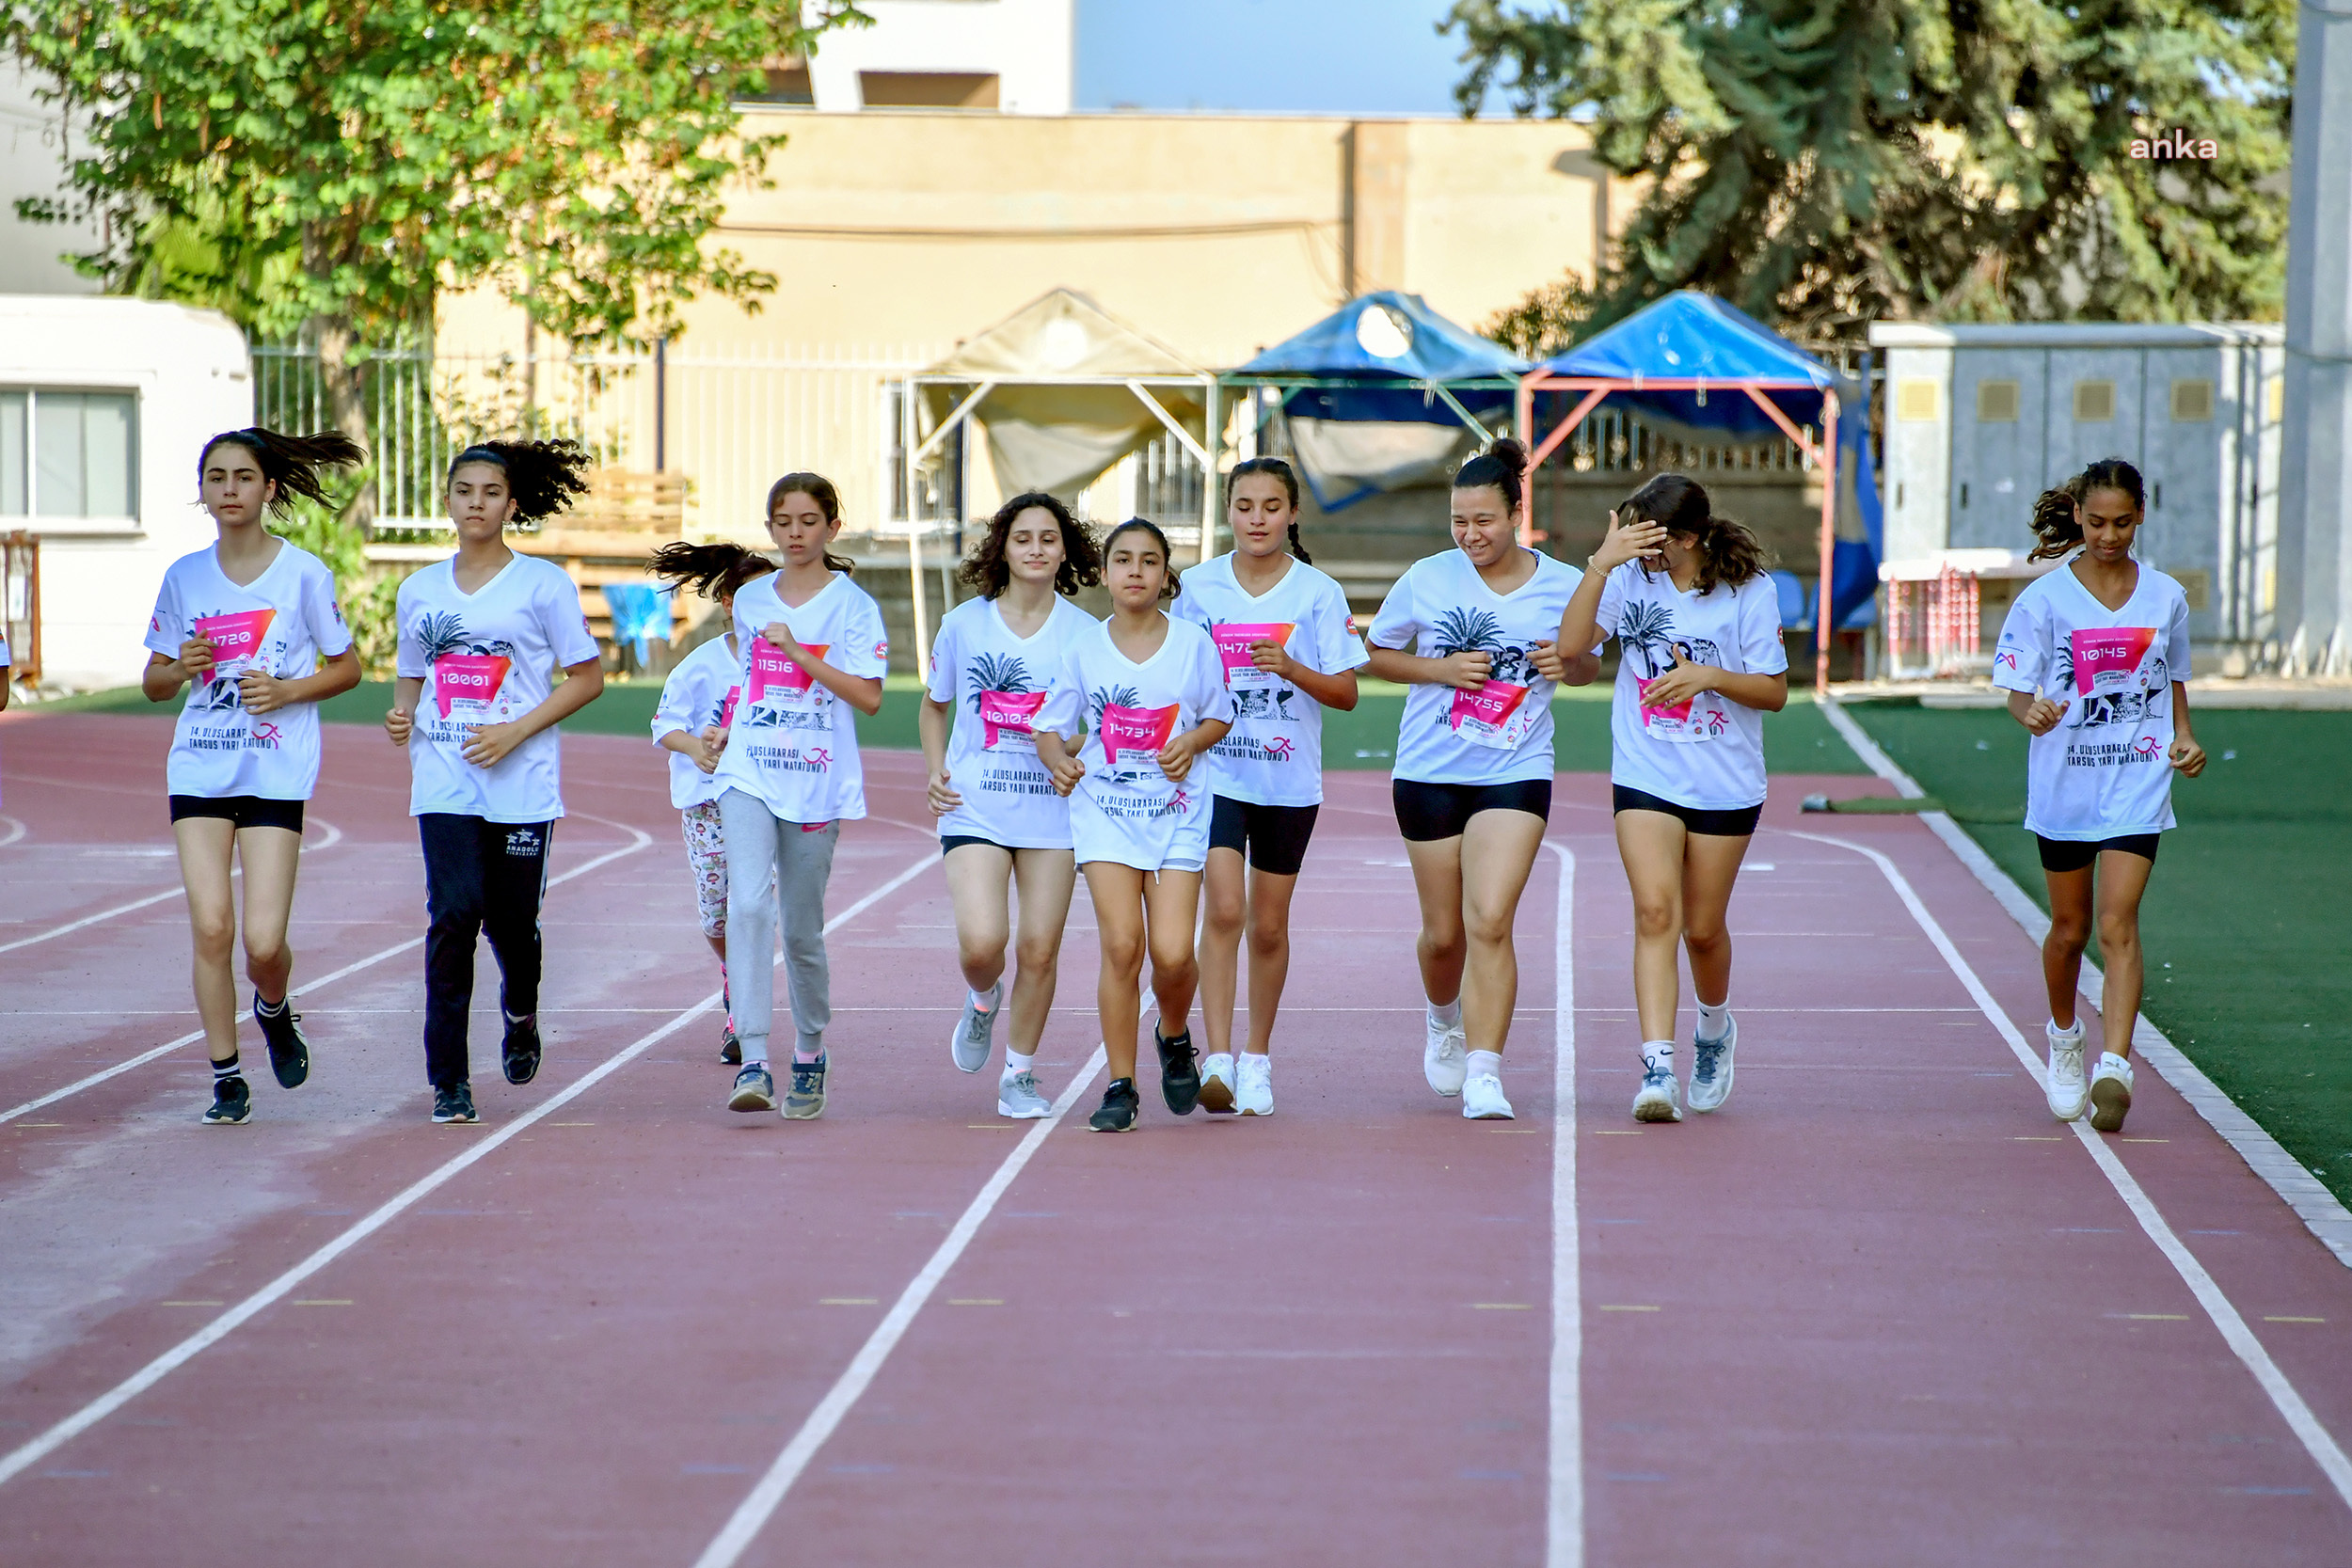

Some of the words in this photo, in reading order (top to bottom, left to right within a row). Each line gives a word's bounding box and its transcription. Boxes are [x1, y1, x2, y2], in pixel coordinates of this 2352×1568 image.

[2080, 647, 2127, 661] 10145
[757, 658, 794, 673] 11516
[441, 673, 489, 687] 10001
[1459, 690, 1504, 713] 14755
[1109, 722, 1155, 738] 14734
[189, 738, 218, 751] TARSUS
[221, 739, 239, 751] YARI
[1229, 749, 1246, 758] YARI
[763, 759, 781, 769] YARI
[2067, 755, 2096, 768] TARSUS
[2098, 755, 2116, 767] YARI
[993, 768, 1044, 783] ULUSLARARASI
[979, 781, 1007, 792] TARSUS
[1009, 783, 1025, 794] YARI
[1108, 796, 1166, 809] ULUSLARARASI
[1126, 809, 1144, 818] YARI
